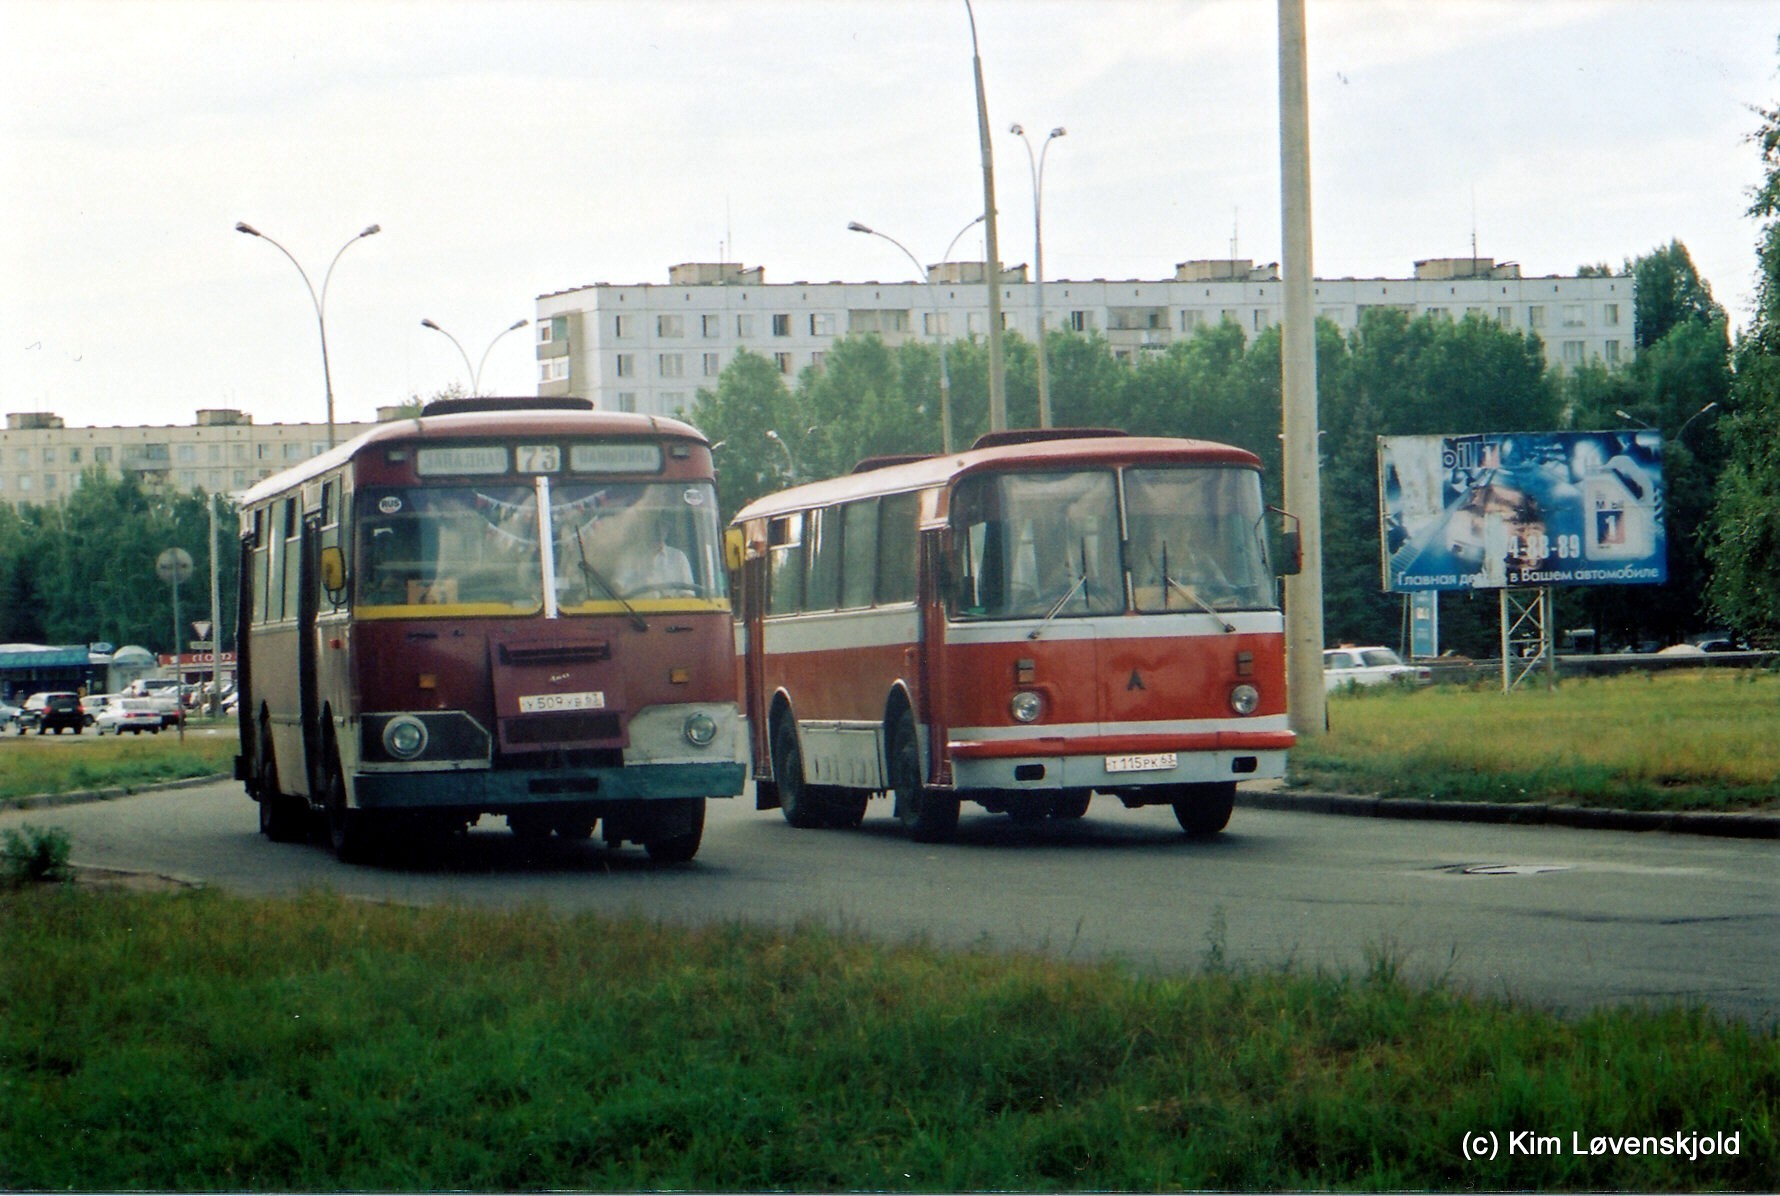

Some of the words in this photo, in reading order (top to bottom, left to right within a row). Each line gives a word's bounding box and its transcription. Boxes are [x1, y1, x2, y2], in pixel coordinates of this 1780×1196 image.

[1398, 571, 1457, 586] Главная
[1510, 572, 1518, 582] в
[1521, 567, 1573, 582] Вашем
[1574, 564, 1660, 581] автомобиле
